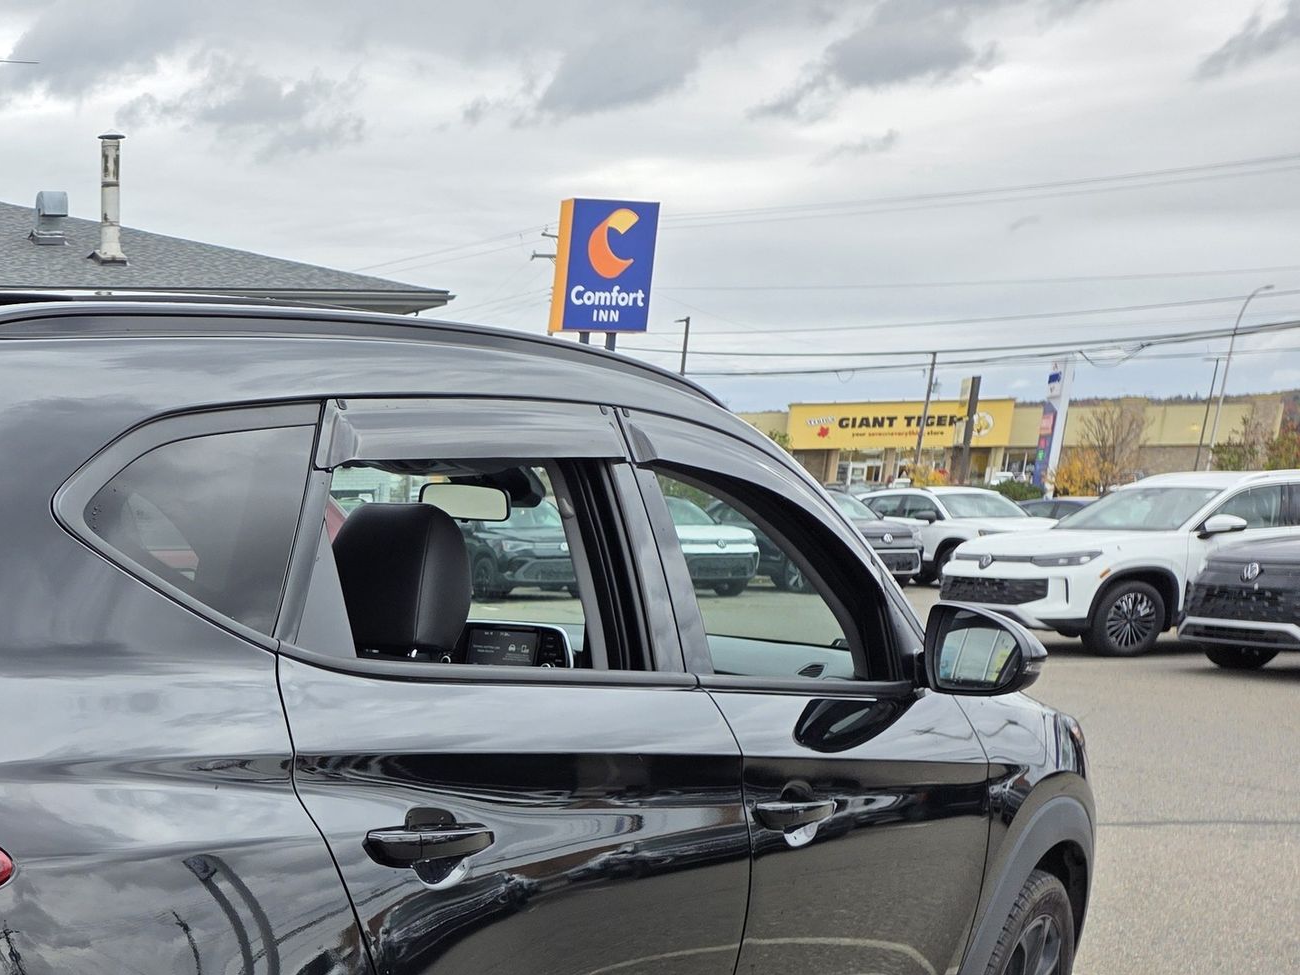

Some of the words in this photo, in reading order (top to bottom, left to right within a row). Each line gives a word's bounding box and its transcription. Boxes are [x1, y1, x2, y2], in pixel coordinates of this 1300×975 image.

[571, 285, 645, 307] Comfort
[592, 309, 620, 322] INN
[838, 416, 898, 429] GIANT
[904, 415, 961, 428] TIGER
